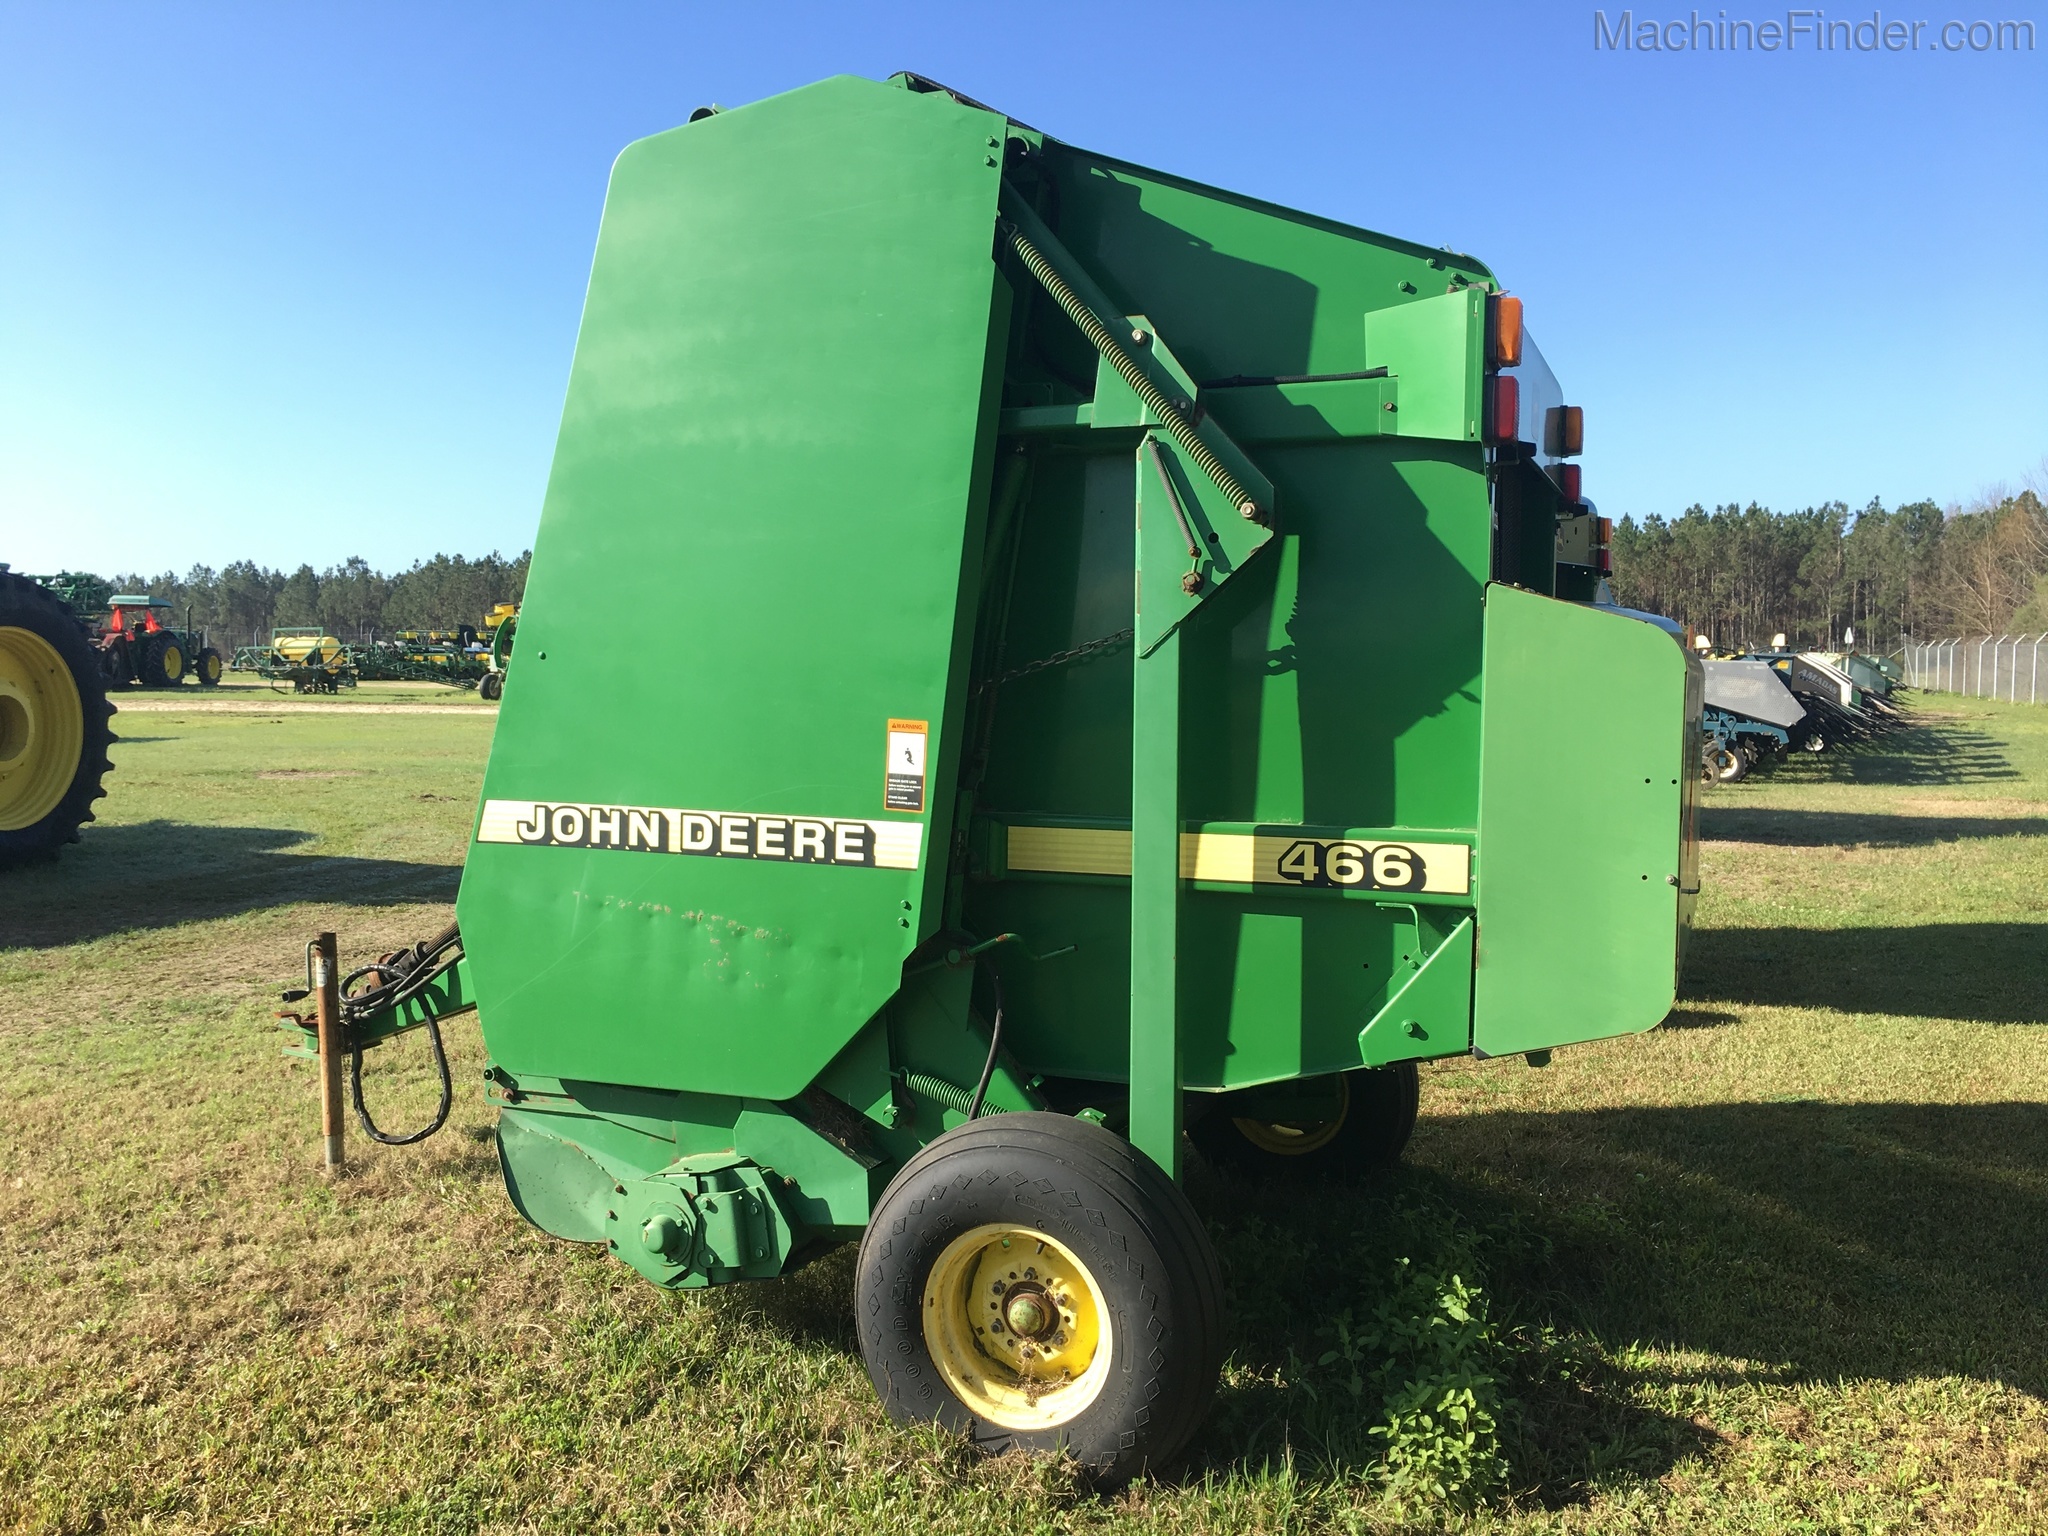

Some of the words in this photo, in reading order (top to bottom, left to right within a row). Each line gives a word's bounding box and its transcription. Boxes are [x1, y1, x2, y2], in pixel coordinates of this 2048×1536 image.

[1798, 669, 1839, 695] AMADAS
[517, 805, 666, 852] JOHN
[677, 813, 876, 866] DEERE
[1278, 841, 1427, 891] 466
